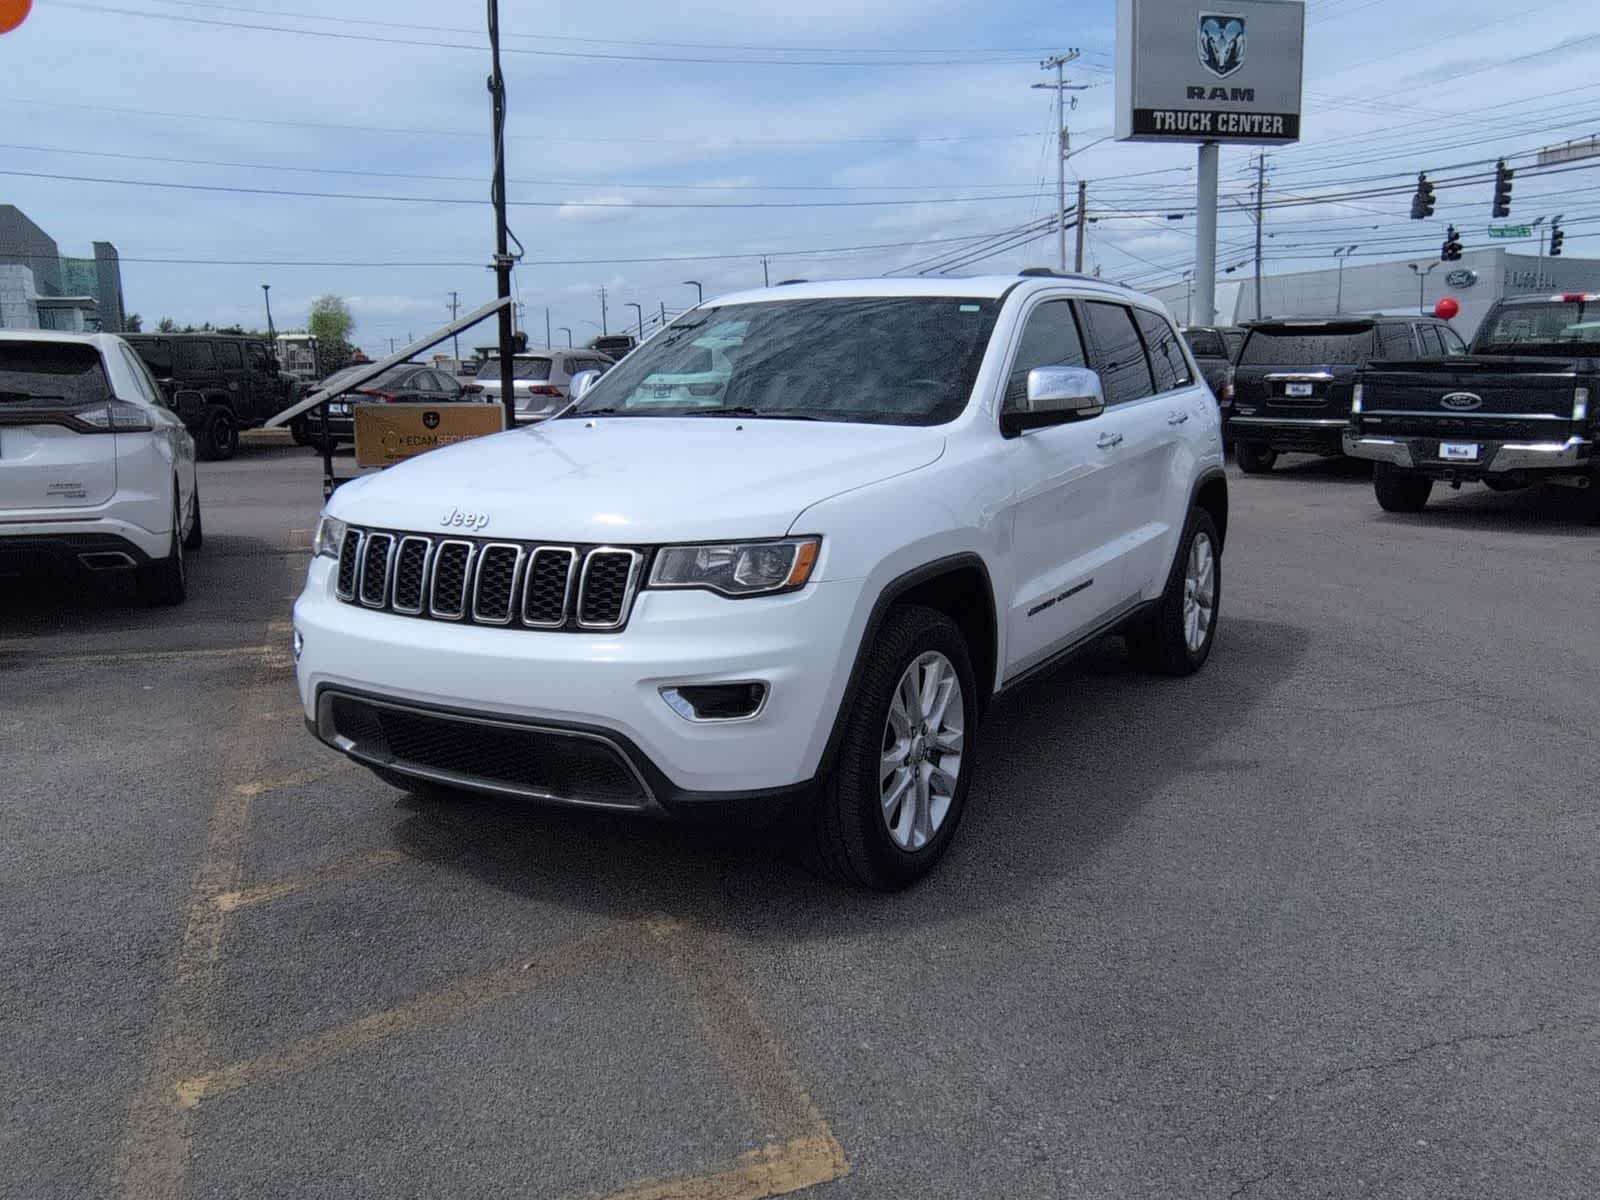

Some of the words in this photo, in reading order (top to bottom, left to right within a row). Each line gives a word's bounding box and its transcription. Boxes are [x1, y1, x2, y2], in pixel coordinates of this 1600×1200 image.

[1187, 86, 1255, 102] RAM
[1153, 111, 1212, 131] TRUCK
[1217, 113, 1284, 134] CENTER
[440, 506, 490, 532] Jeep
